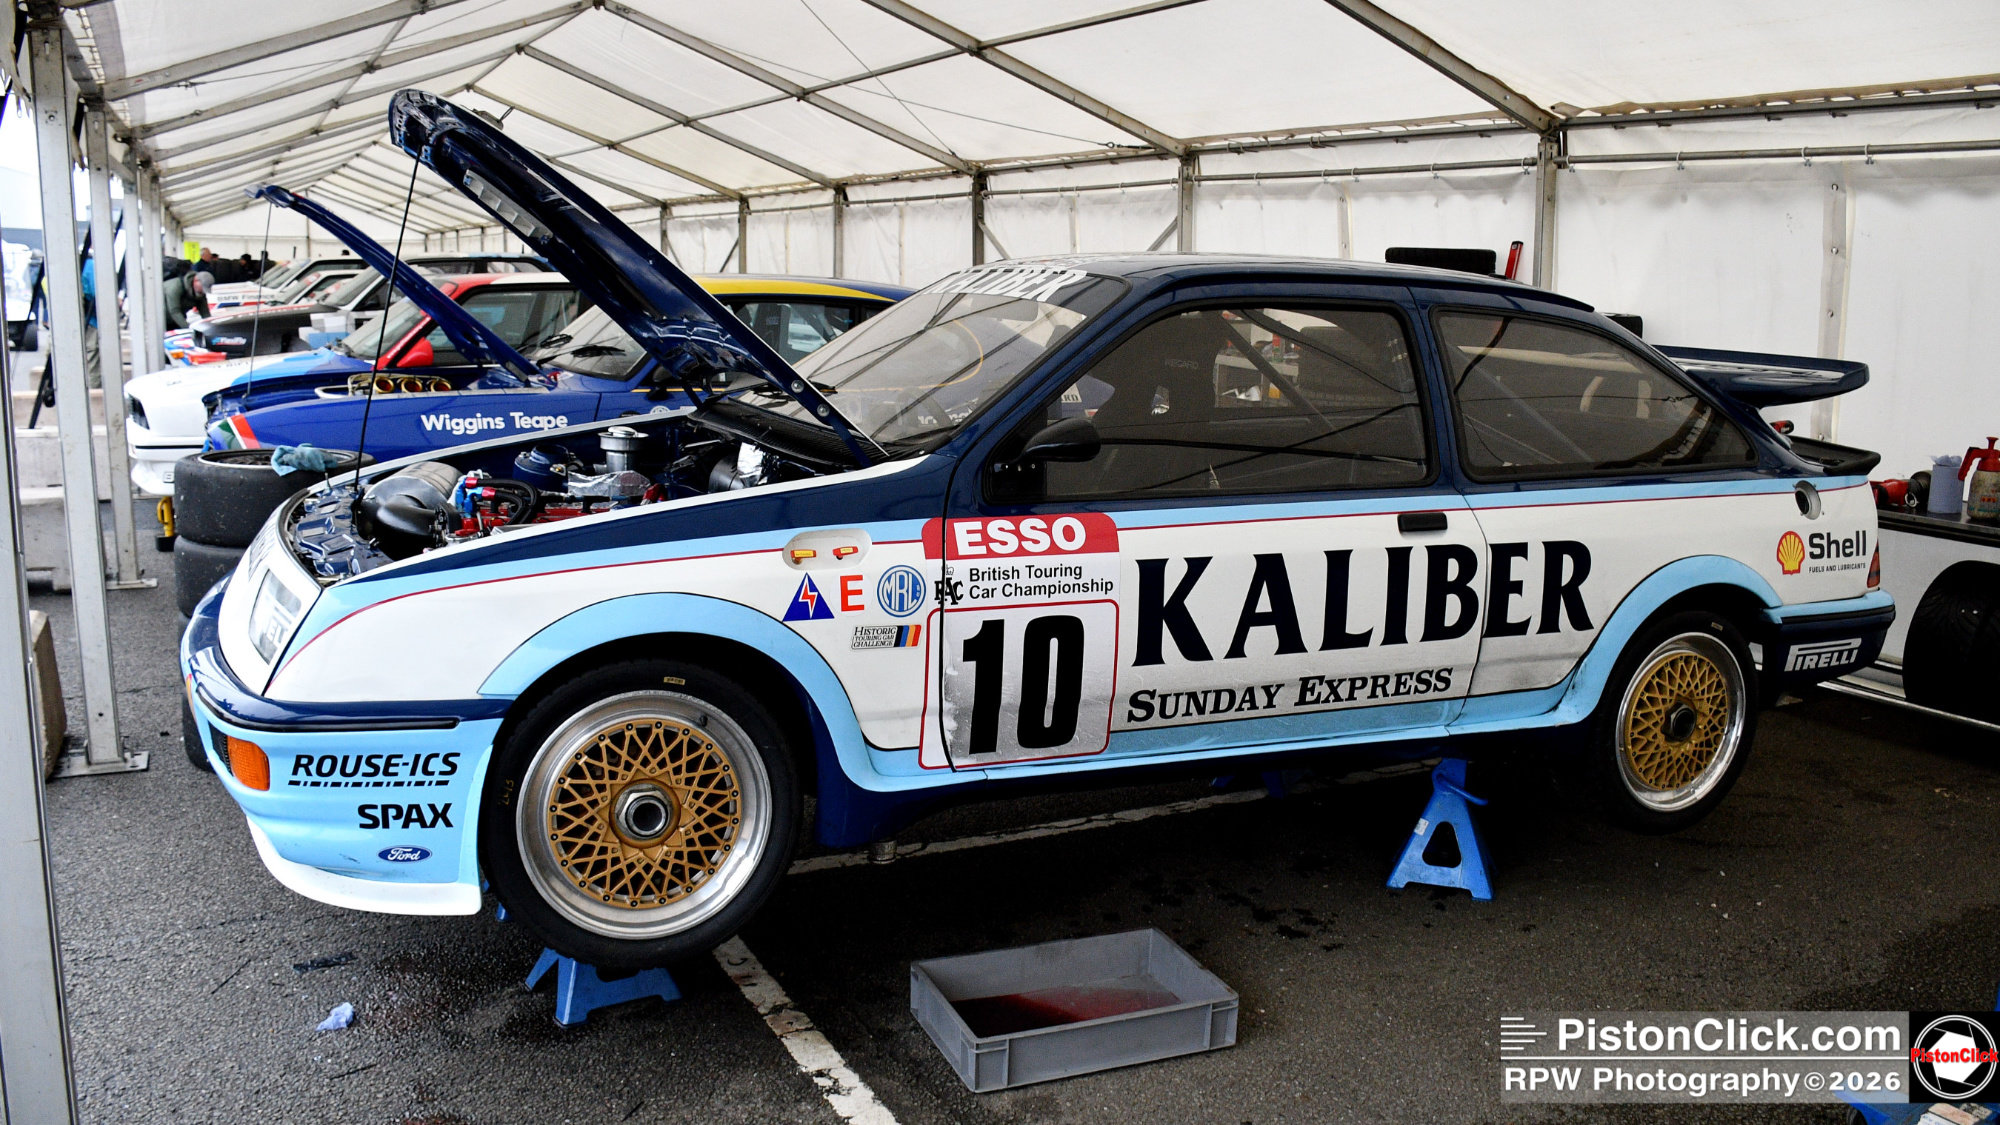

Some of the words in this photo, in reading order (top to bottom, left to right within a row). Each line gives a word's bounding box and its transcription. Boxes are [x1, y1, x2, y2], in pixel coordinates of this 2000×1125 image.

[421, 412, 505, 435] Wiggins
[510, 412, 568, 432] Teape
[954, 516, 1087, 556] ESSO
[1809, 530, 1867, 560] Shell
[969, 566, 1020, 582] British
[1025, 563, 1083, 580] Touring
[1826, 564, 1837, 572] AND
[1837, 562, 1866, 571] LUBRICANTS
[840, 574, 865, 612] E
[882, 571, 919, 610] MRL
[934, 577, 964, 605] RAC
[969, 584, 997, 600] Car
[1001, 578, 1114, 599] Championship
[1132, 540, 1594, 667] KALIBER
[1784, 638, 1862, 672] PIRELLI
[962, 615, 1084, 755] 10
[1127, 683, 1286, 723] SUNDAY
[1294, 667, 1454, 707] EXPRESS
[291, 752, 461, 778] ROUSE-ICS
[357, 803, 454, 830] SPAX
[387, 847, 421, 861] Ford
